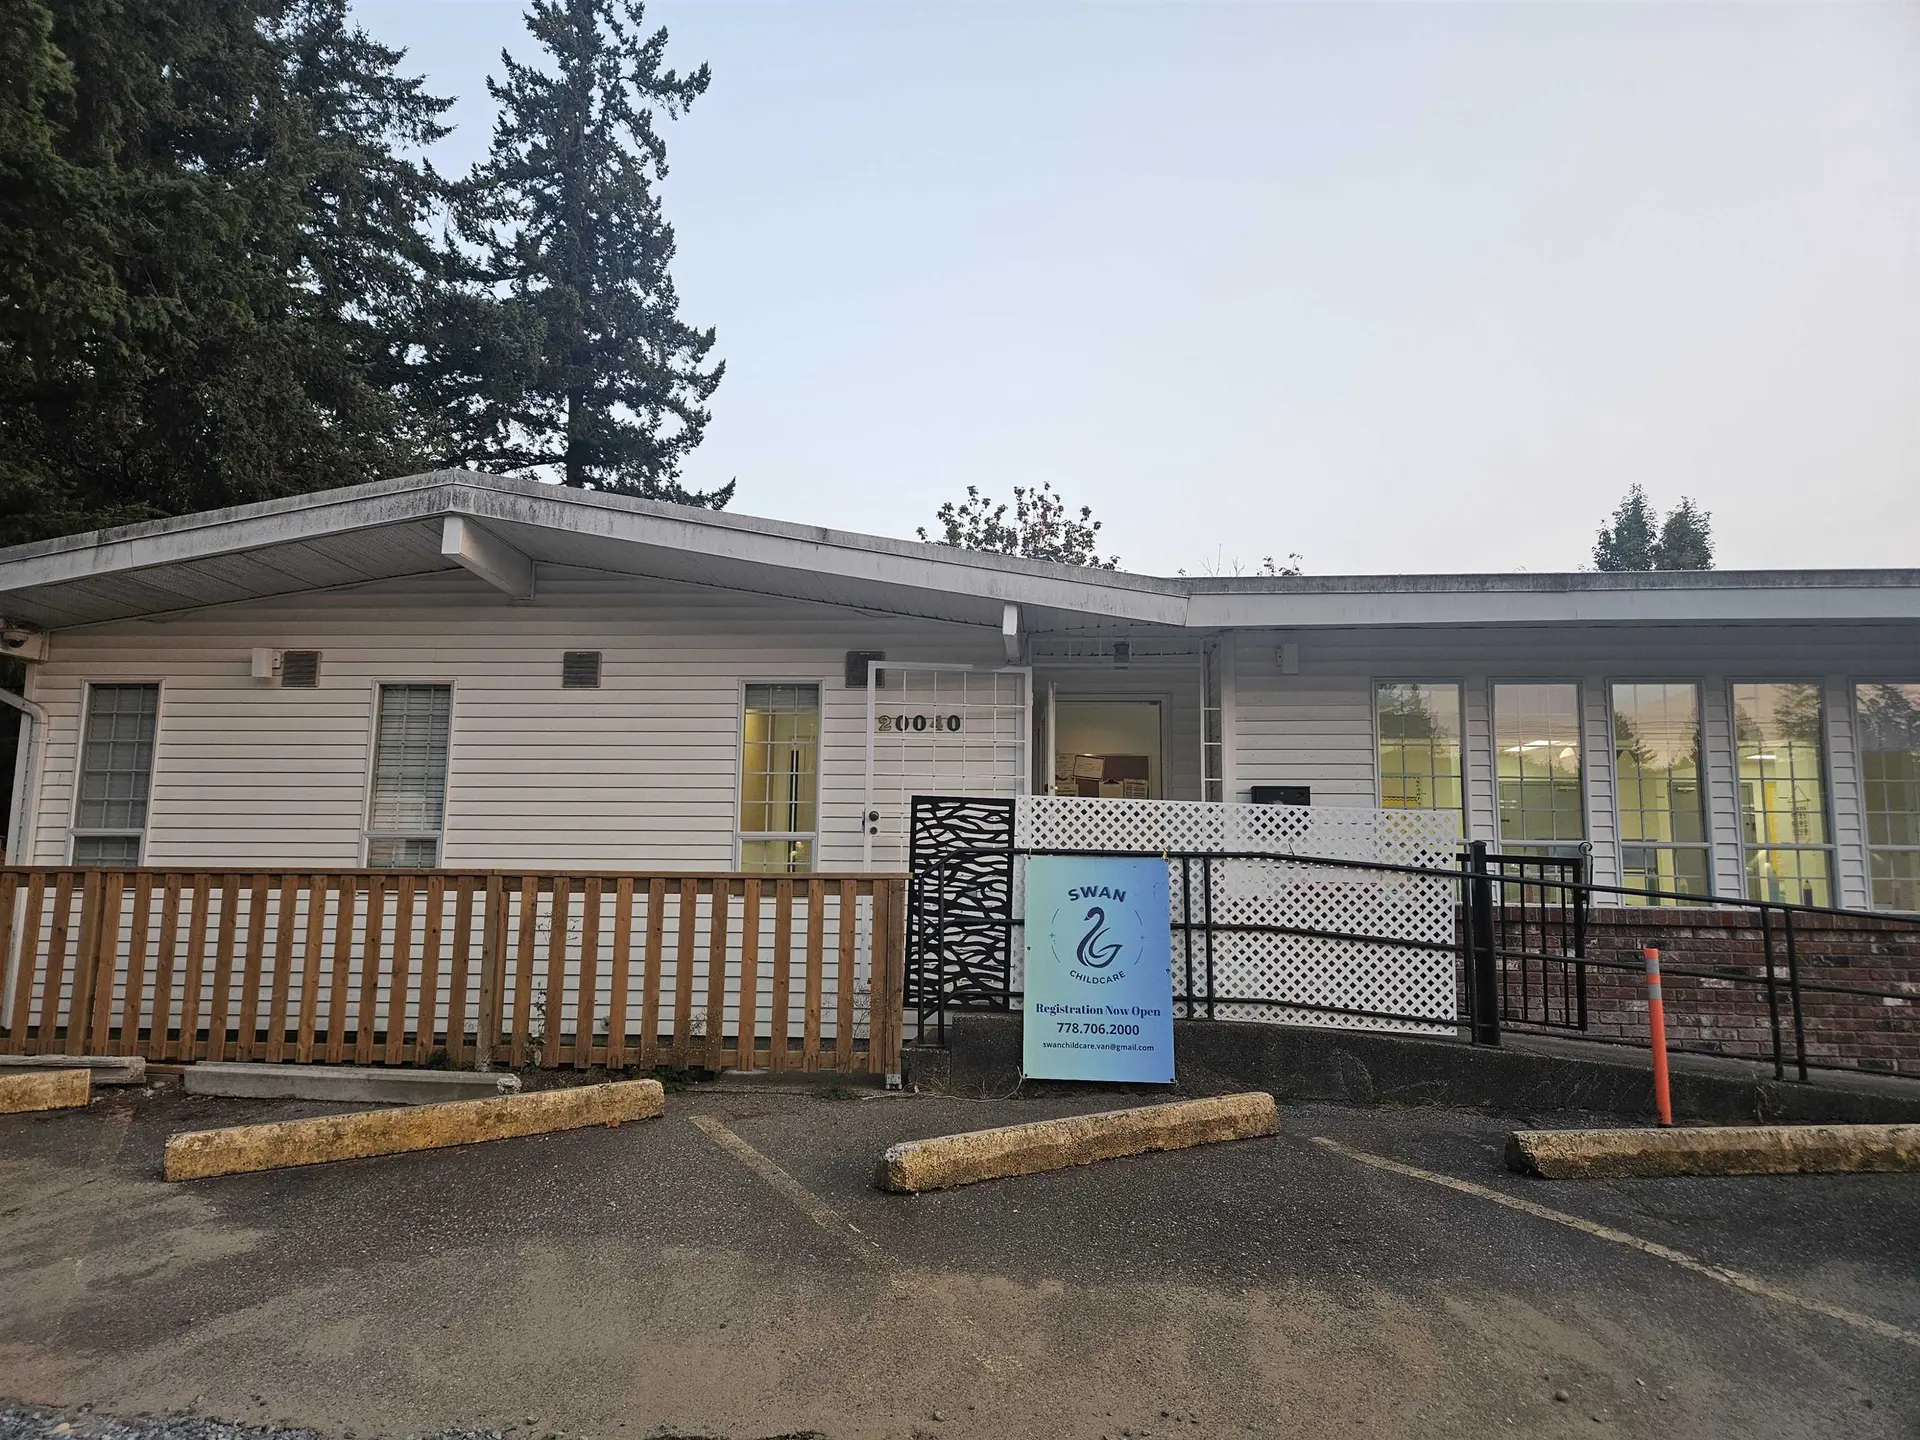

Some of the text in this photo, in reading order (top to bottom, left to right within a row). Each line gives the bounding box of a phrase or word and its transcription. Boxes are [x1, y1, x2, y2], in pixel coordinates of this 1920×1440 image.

[878, 715, 961, 732] 20040
[1067, 885, 1127, 902] SWAN
[1069, 969, 1126, 985] CHILDCARE
[1035, 1003, 1161, 1019] Registration Now Open
[1056, 1022, 1140, 1036] 778.706.2000
[1042, 1041, 1155, 1052] swanchildcare.van@gmail.com
